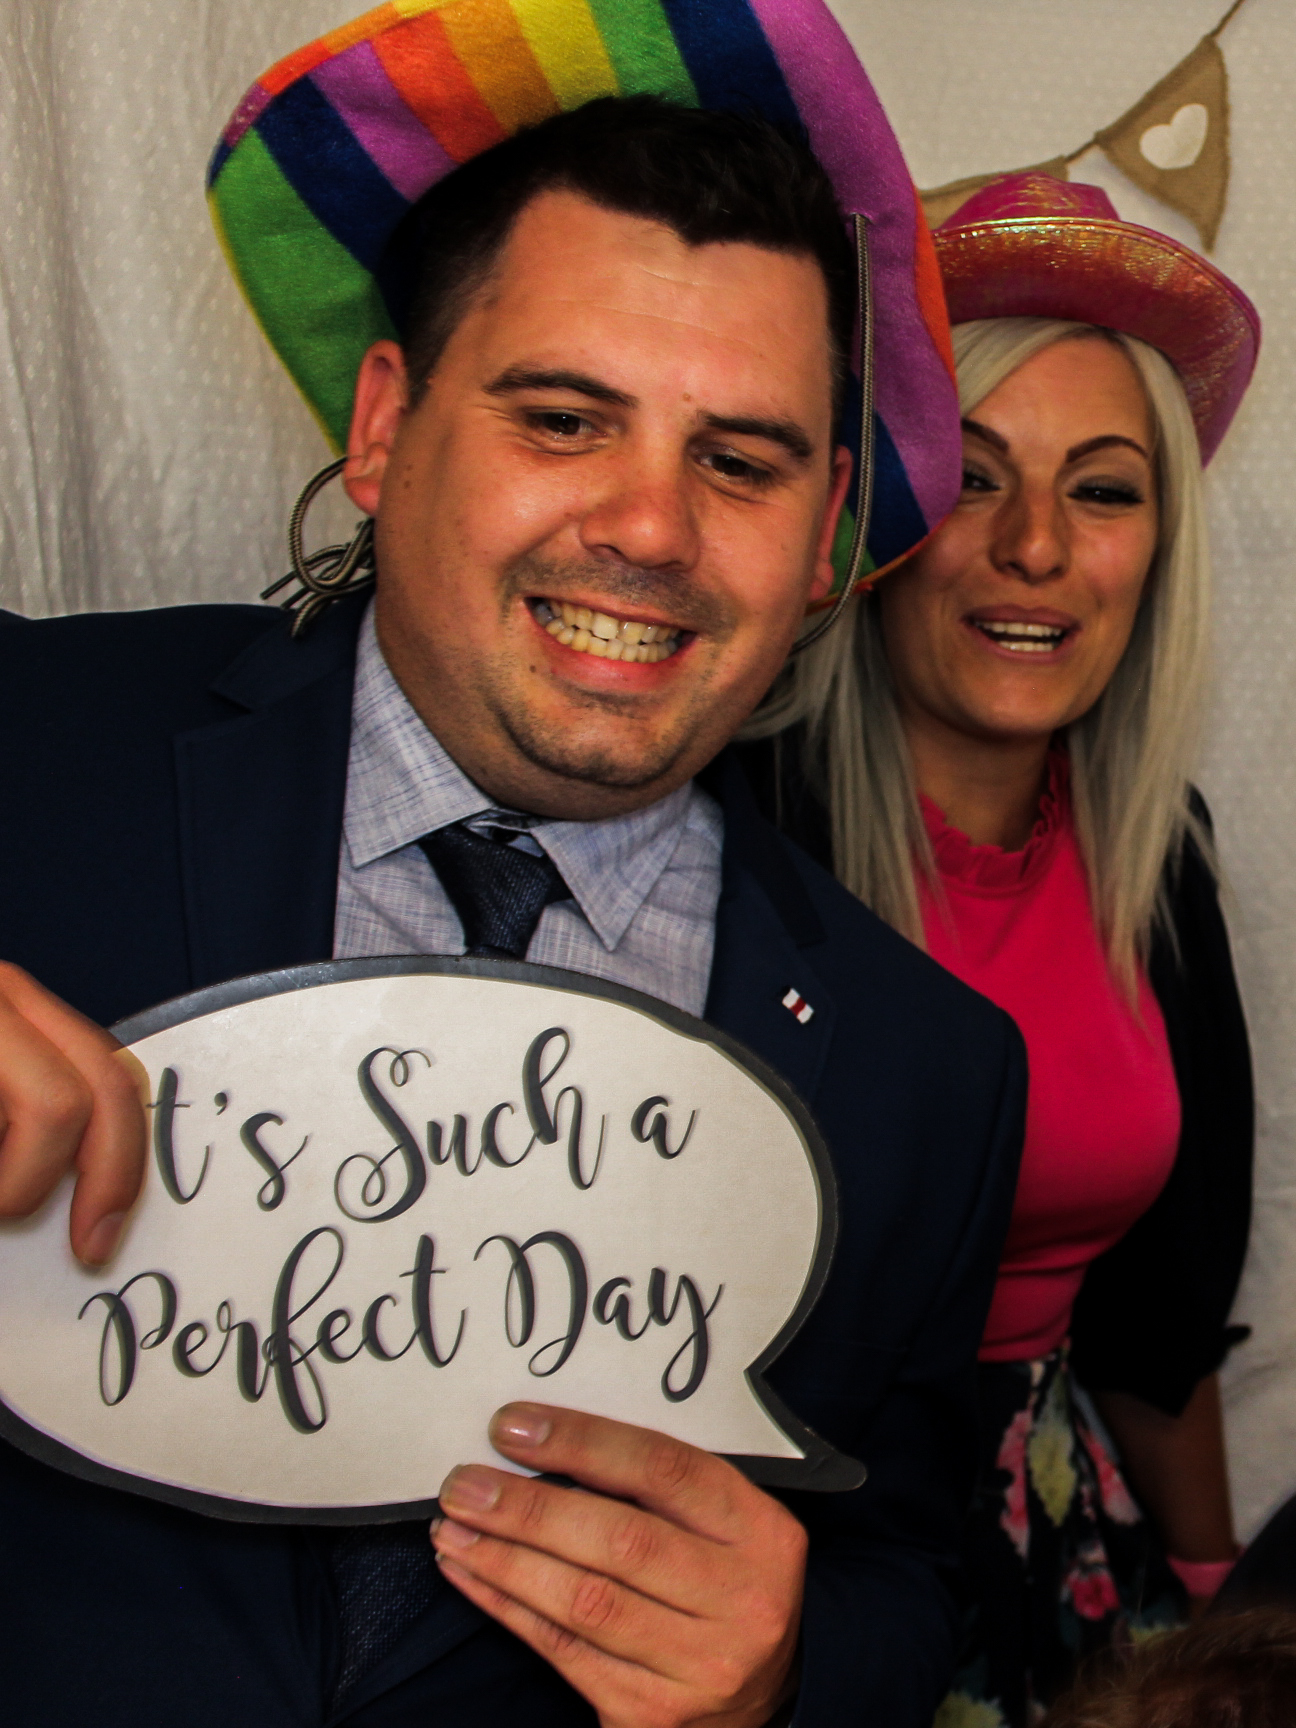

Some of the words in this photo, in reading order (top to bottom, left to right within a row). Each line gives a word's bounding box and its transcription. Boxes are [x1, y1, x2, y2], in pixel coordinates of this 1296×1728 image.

[147, 1067, 308, 1212] t's
[334, 1027, 604, 1222] Such
[630, 1095, 696, 1159] a
[77, 1225, 467, 1434] Perfect
[473, 1230, 724, 1402] Day
